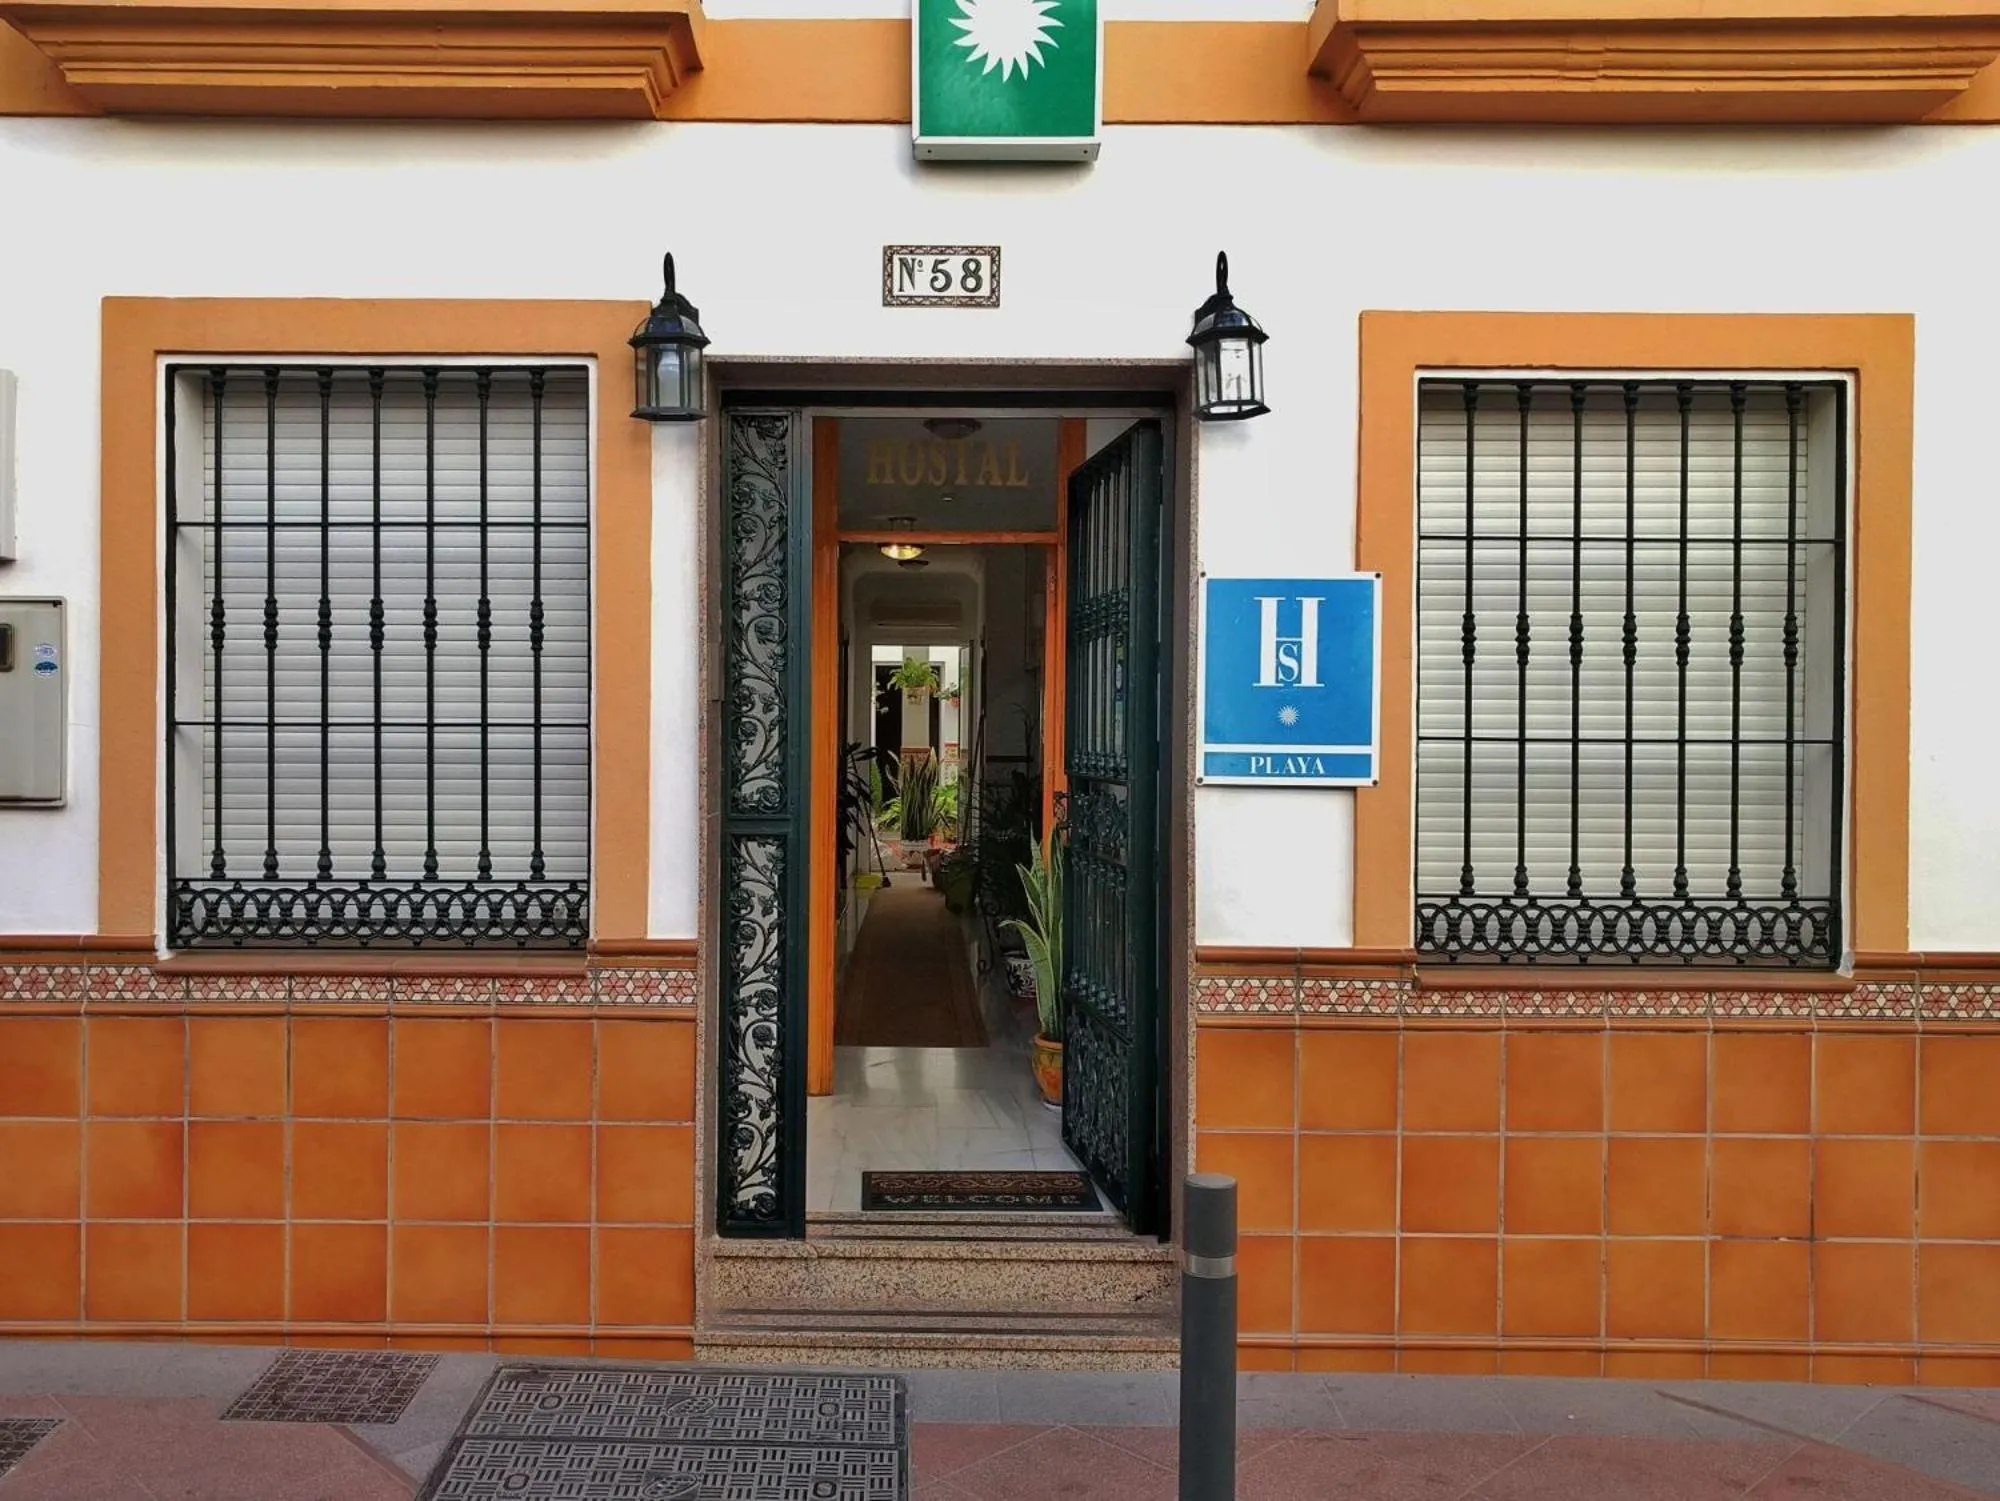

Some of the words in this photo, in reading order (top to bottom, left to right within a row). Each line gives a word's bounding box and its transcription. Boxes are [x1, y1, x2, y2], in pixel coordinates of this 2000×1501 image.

[930, 257, 983, 293] 58
[866, 440, 1029, 487] HOSTAL
[1250, 756, 1325, 775] PLAYA
[884, 1194, 1081, 1206] WELCOME
